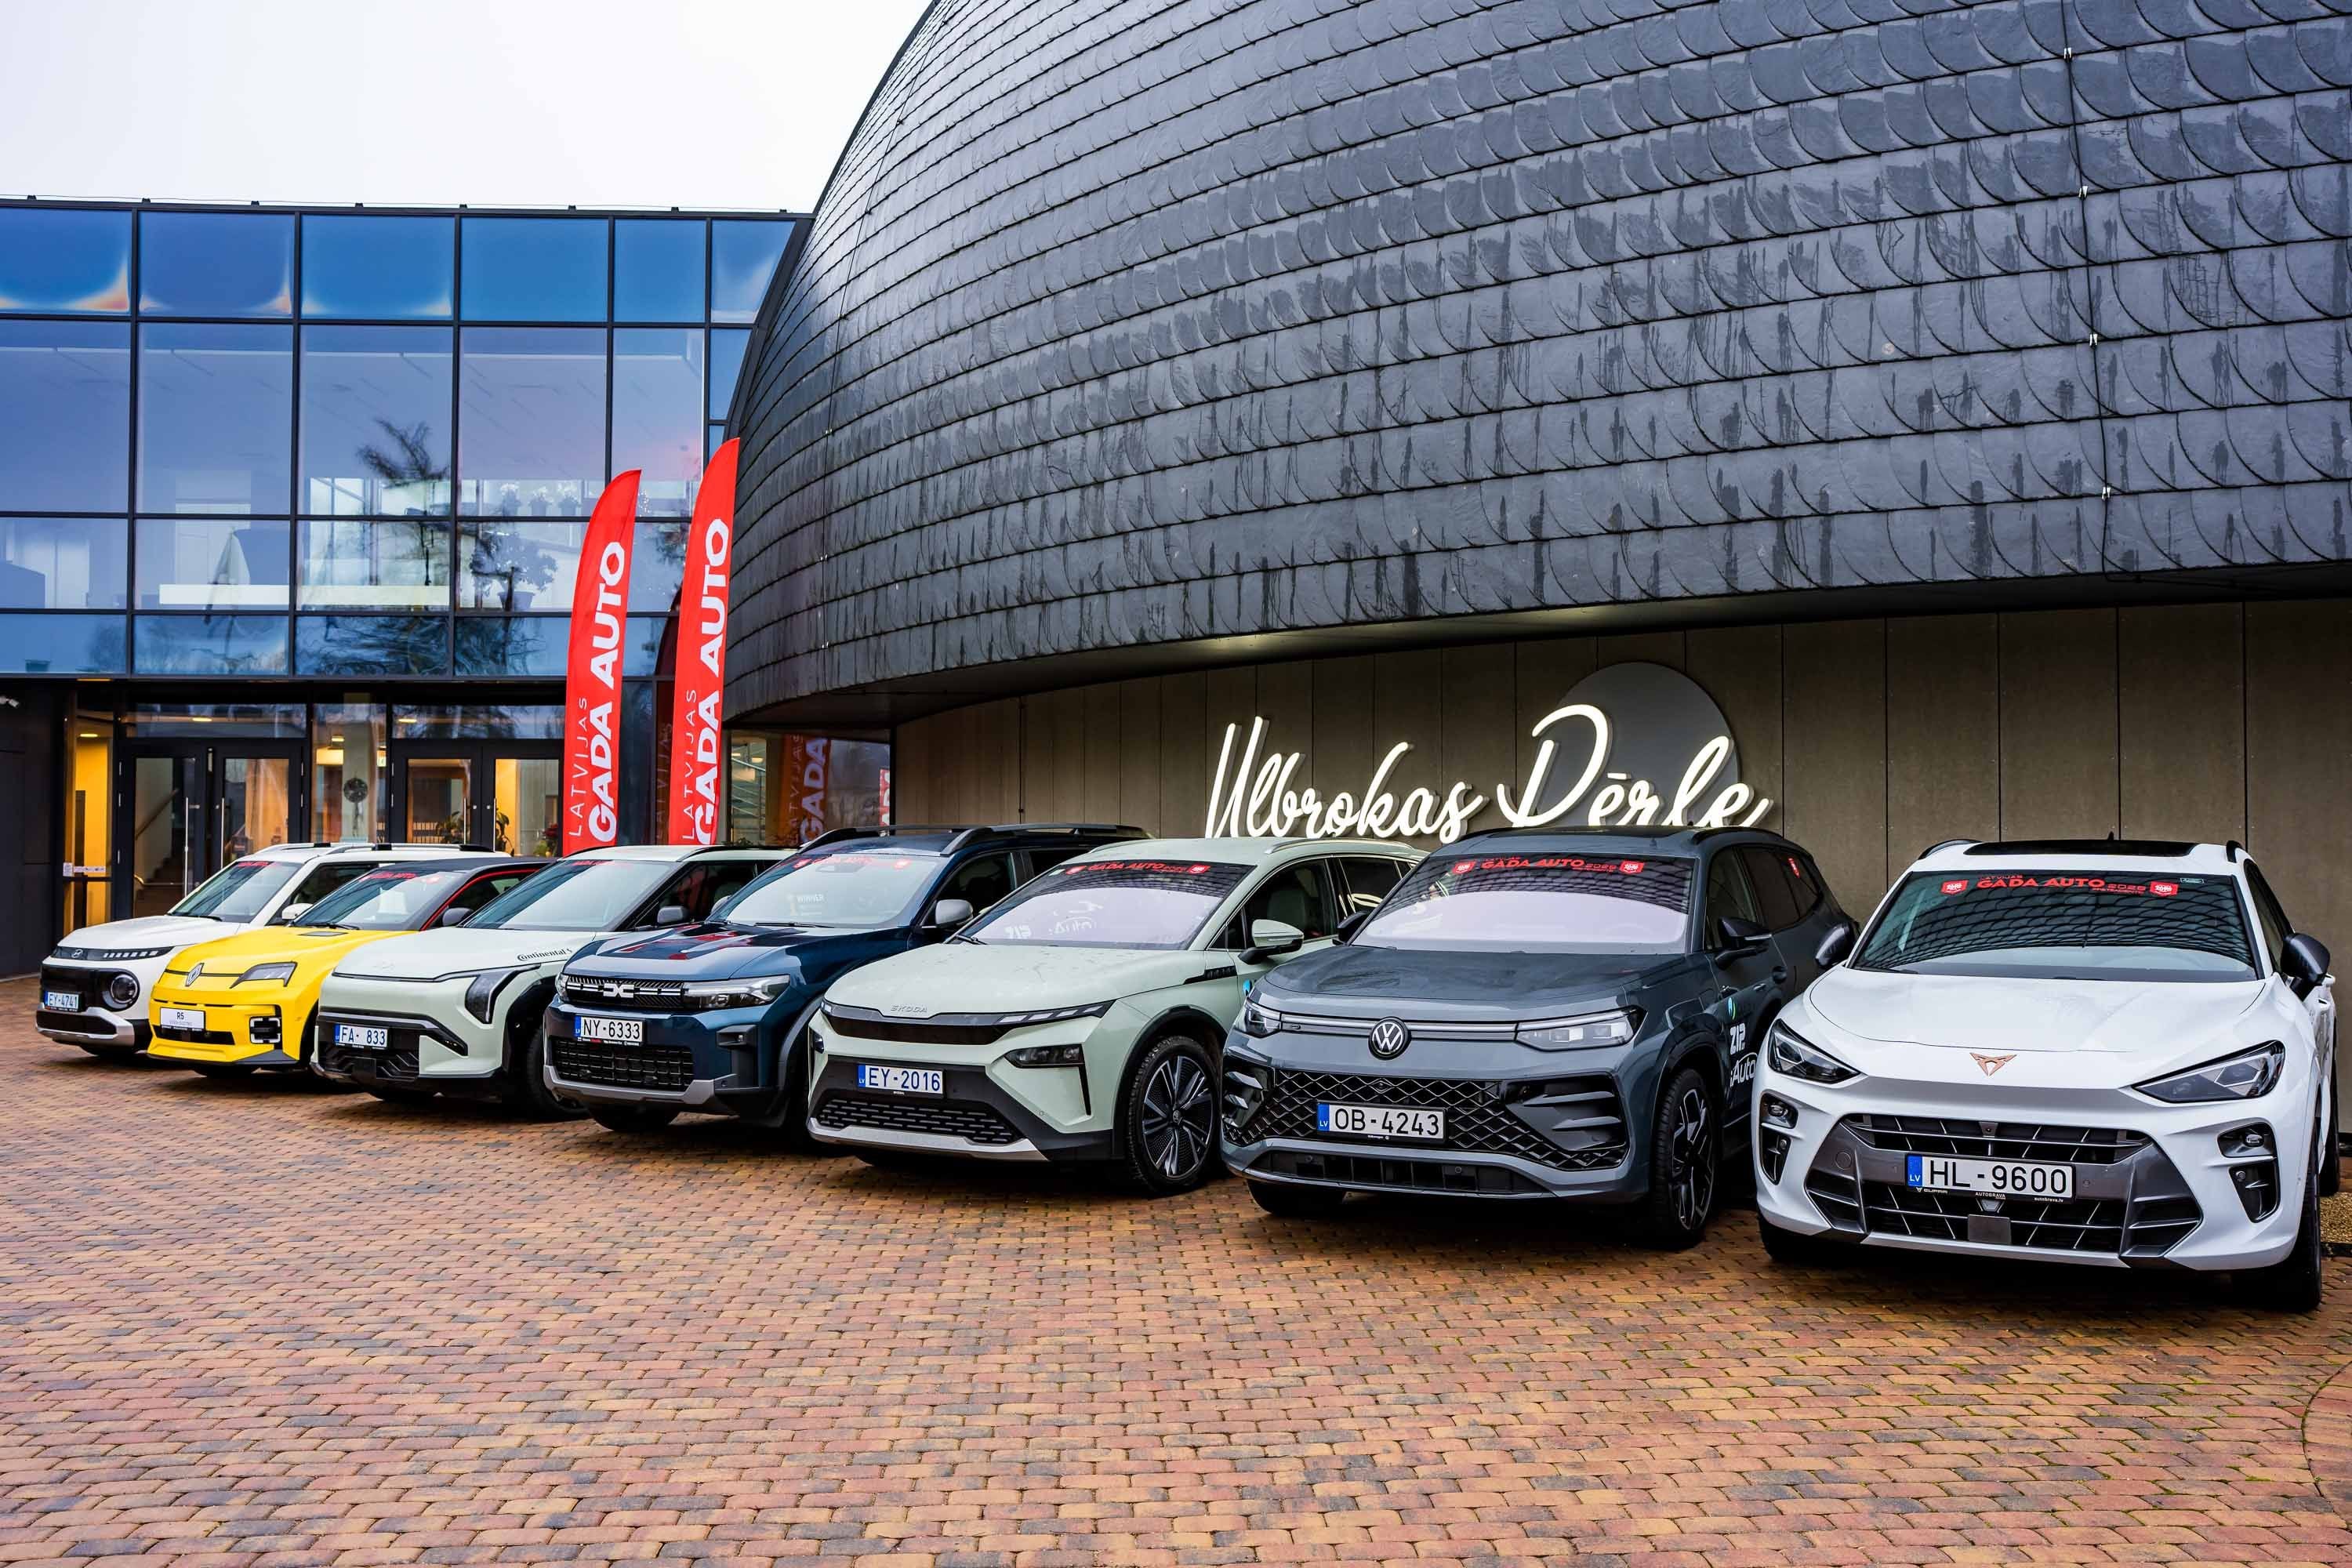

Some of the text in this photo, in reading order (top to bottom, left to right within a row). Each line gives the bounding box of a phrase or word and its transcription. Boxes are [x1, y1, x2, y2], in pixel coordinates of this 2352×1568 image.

[590, 542, 626, 689] AUTO
[695, 518, 730, 844] GADA AUTO
[568, 696, 588, 837] LATVIJAS
[589, 702, 618, 843] GADA
[681, 689, 697, 840] LATVIJAS
[1205, 716, 1485, 844] Ulbrokas
[1479, 859, 1530, 869] GADA
[1535, 859, 1585, 868] AUTO
[1976, 878, 2038, 889] GADA
[2043, 877, 2106, 887] AUTO
[517, 949, 567, 961] Continental
[176, 1011, 185, 1020] R5
[869, 1067, 941, 1091] EY-2016
[1334, 1108, 1439, 1136] OB-4243
[1929, 1160, 2067, 1194] HL-9600
